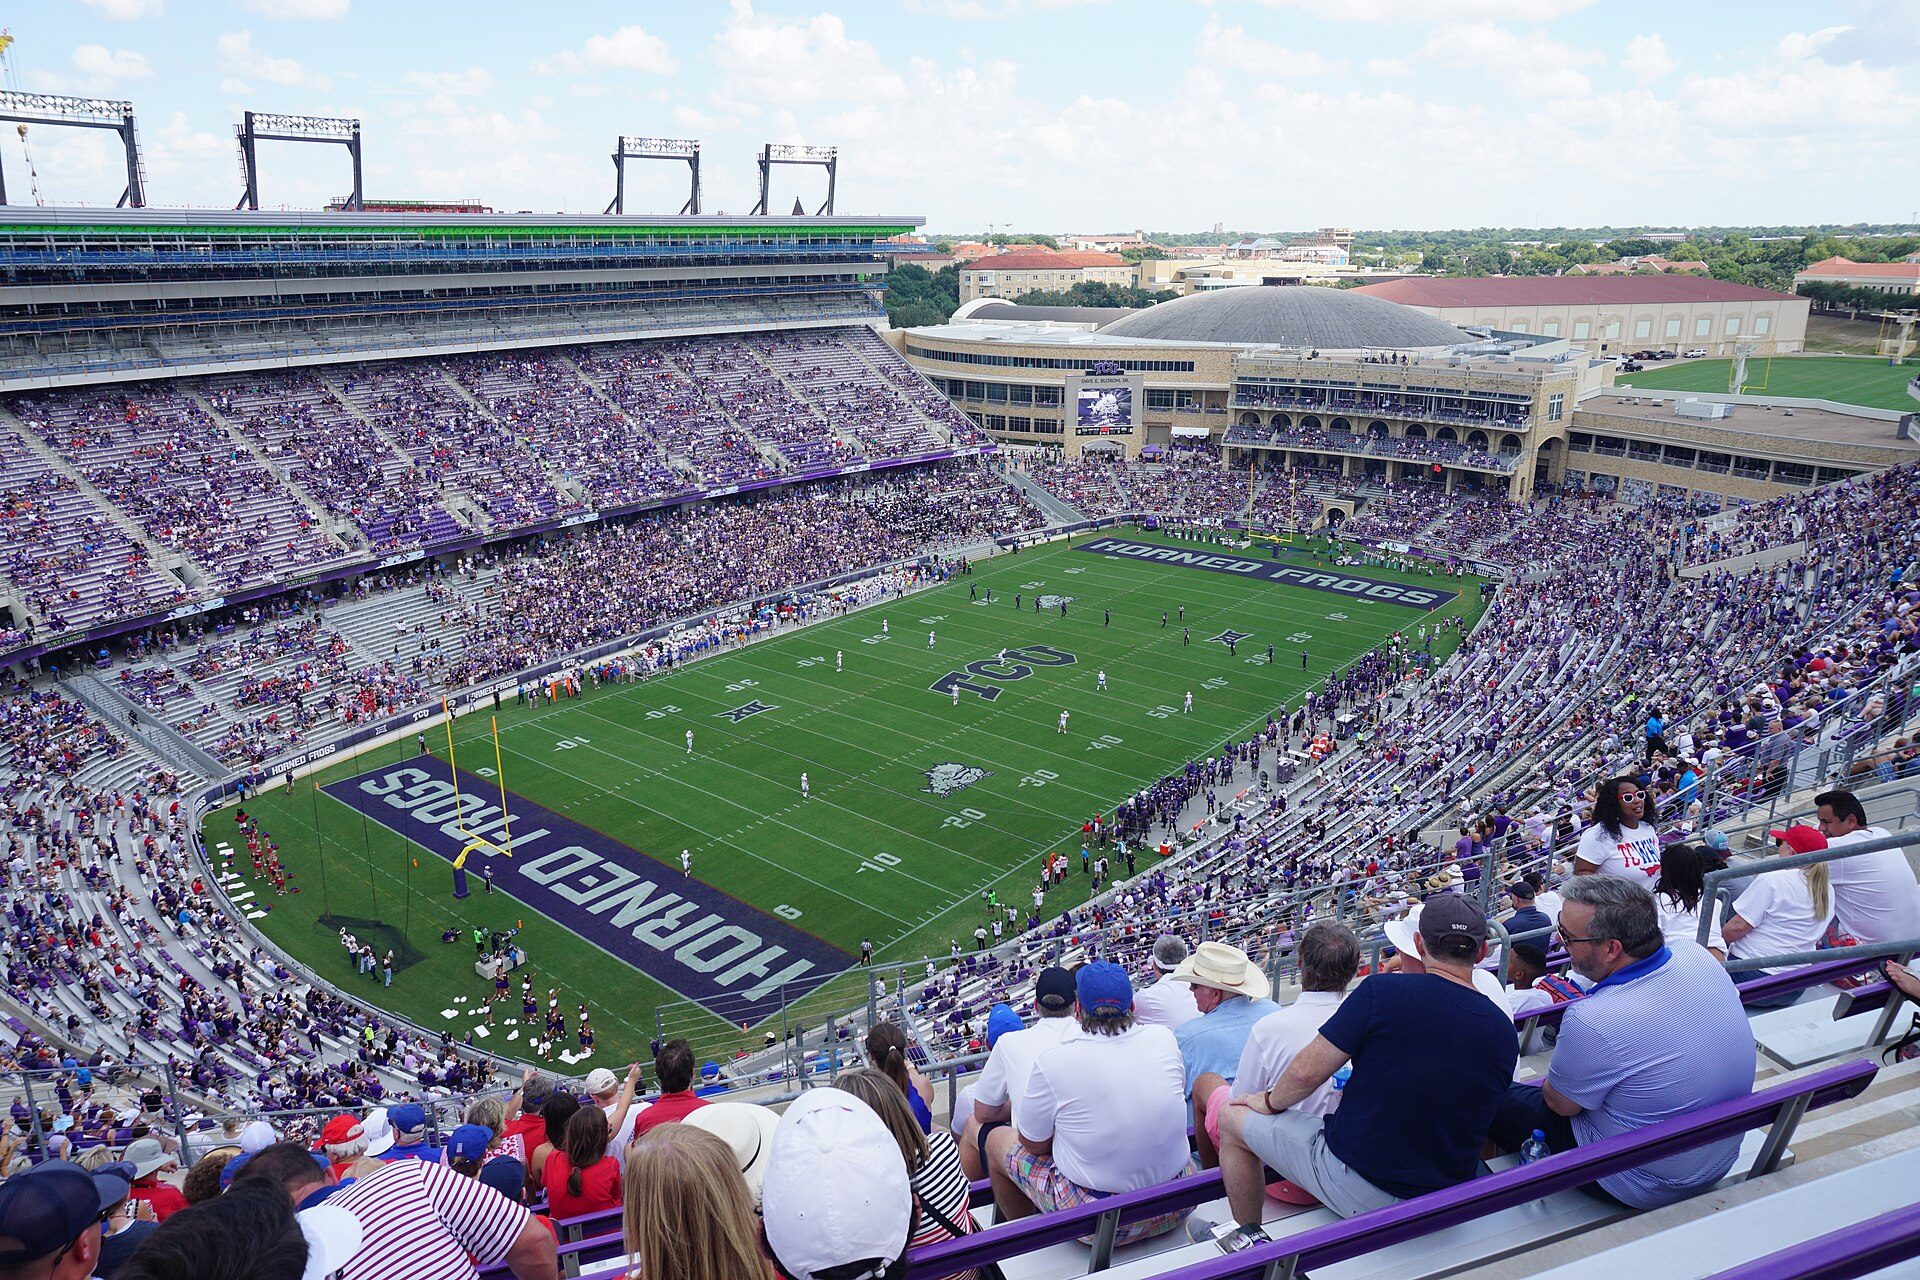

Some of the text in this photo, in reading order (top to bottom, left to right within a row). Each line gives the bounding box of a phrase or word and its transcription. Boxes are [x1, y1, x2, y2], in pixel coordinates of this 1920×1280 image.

[1094, 361, 1118, 375] TCU
[1089, 541, 1263, 573] HORNED
[1270, 568, 1439, 604] FROGS
[561, 658, 576, 669] TCU
[928, 645, 1078, 702] TCU
[495, 678, 518, 691] FROGS
[413, 709, 429, 721] TCU
[646, 704, 682, 719] 20
[1147, 704, 1179, 719] 50
[556, 736, 590, 749] 10
[1090, 735, 1123, 750] 40
[271, 743, 336, 776] HORNED FROGS
[1023, 769, 1059, 788] 30
[944, 808, 987, 829] 20
[1617, 838, 1660, 867] TCWH
[860, 852, 902, 872] 10
[358, 767, 816, 1002] HORNED FROGS
[773, 904, 803, 920] G
[1451, 923, 1468, 931] SMU
